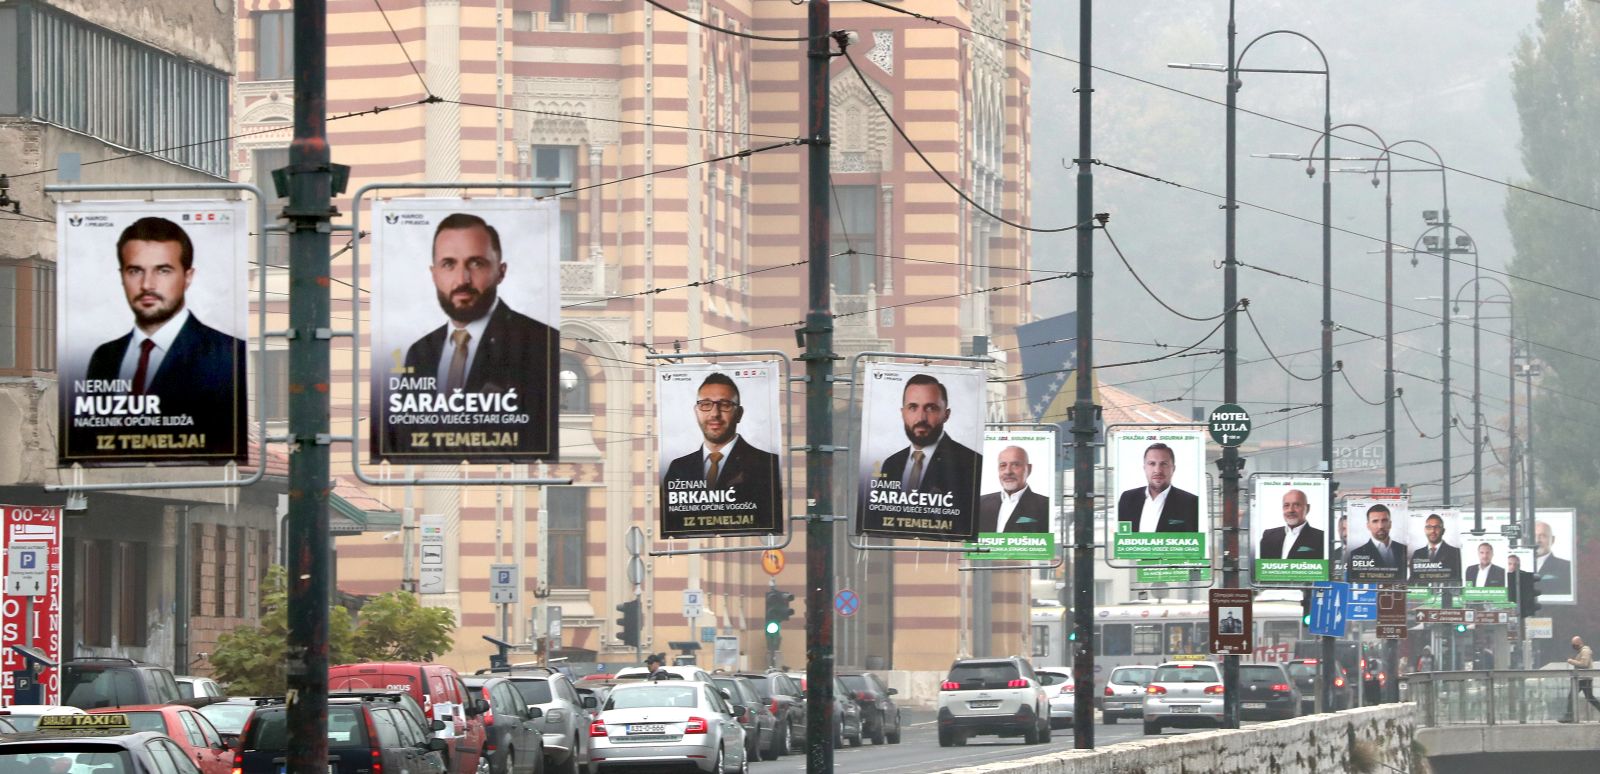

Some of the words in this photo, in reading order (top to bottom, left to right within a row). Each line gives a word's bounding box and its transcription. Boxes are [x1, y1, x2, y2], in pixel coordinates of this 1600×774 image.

[389, 348, 415, 374] 1.
[74, 380, 132, 393] NERMIN
[389, 377, 437, 391] DAMIR
[74, 395, 161, 416] MUZUR
[389, 388, 519, 413] SARAČEVIĆ
[74, 416, 123, 428] NAČELNIK
[124, 415, 161, 427] OPĆINE
[162, 413, 194, 426] ILIDŽA
[389, 414, 439, 425] OPĆINSKO
[441, 413, 471, 425] VIJEĆE
[473, 414, 500, 424] STARI
[501, 414, 529, 424] GRAD
[1212, 412, 1250, 421] HOTEL
[1213, 423, 1248, 432] LULA
[96, 435, 115, 450] IZ
[118, 434, 206, 450] TEMELJA!
[411, 432, 430, 447] IZ
[433, 432, 519, 447] TEMELJA!
[1335, 459, 1383, 469] ESTORAN
[668, 478, 707, 490] DŽENAN
[870, 479, 901, 490] DAMIR
[668, 486, 736, 505] BRKANIĆ
[869, 489, 954, 507] SARAČEVIĆ
[669, 503, 700, 513] NAČELNIK
[701, 503, 725, 512] OPĆINE
[868, 504, 901, 513] OPĆINSKO
[923, 506, 941, 514] STARI
[942, 507, 961, 516] GRAD
[683, 516, 696, 526] IZ
[697, 515, 754, 526] TEMELJA!
[882, 516, 894, 526] IZ
[897, 517, 953, 530] TEMELJA!
[972, 537, 1005, 546] USUF
[1007, 535, 1047, 546] PUŠINA
[1117, 538, 1165, 546] ABDULAH
[1165, 538, 1199, 546] SKAKA
[22, 554, 33, 566] P
[1261, 562, 1289, 570] JUSUF
[1290, 561, 1323, 570] PUŠINA
[1413, 561, 1443, 569] BRKANIĆ
[3, 576, 19, 706] OSTE
[20, 680, 27, 688] P
[73, 715, 110, 726] TAXI
